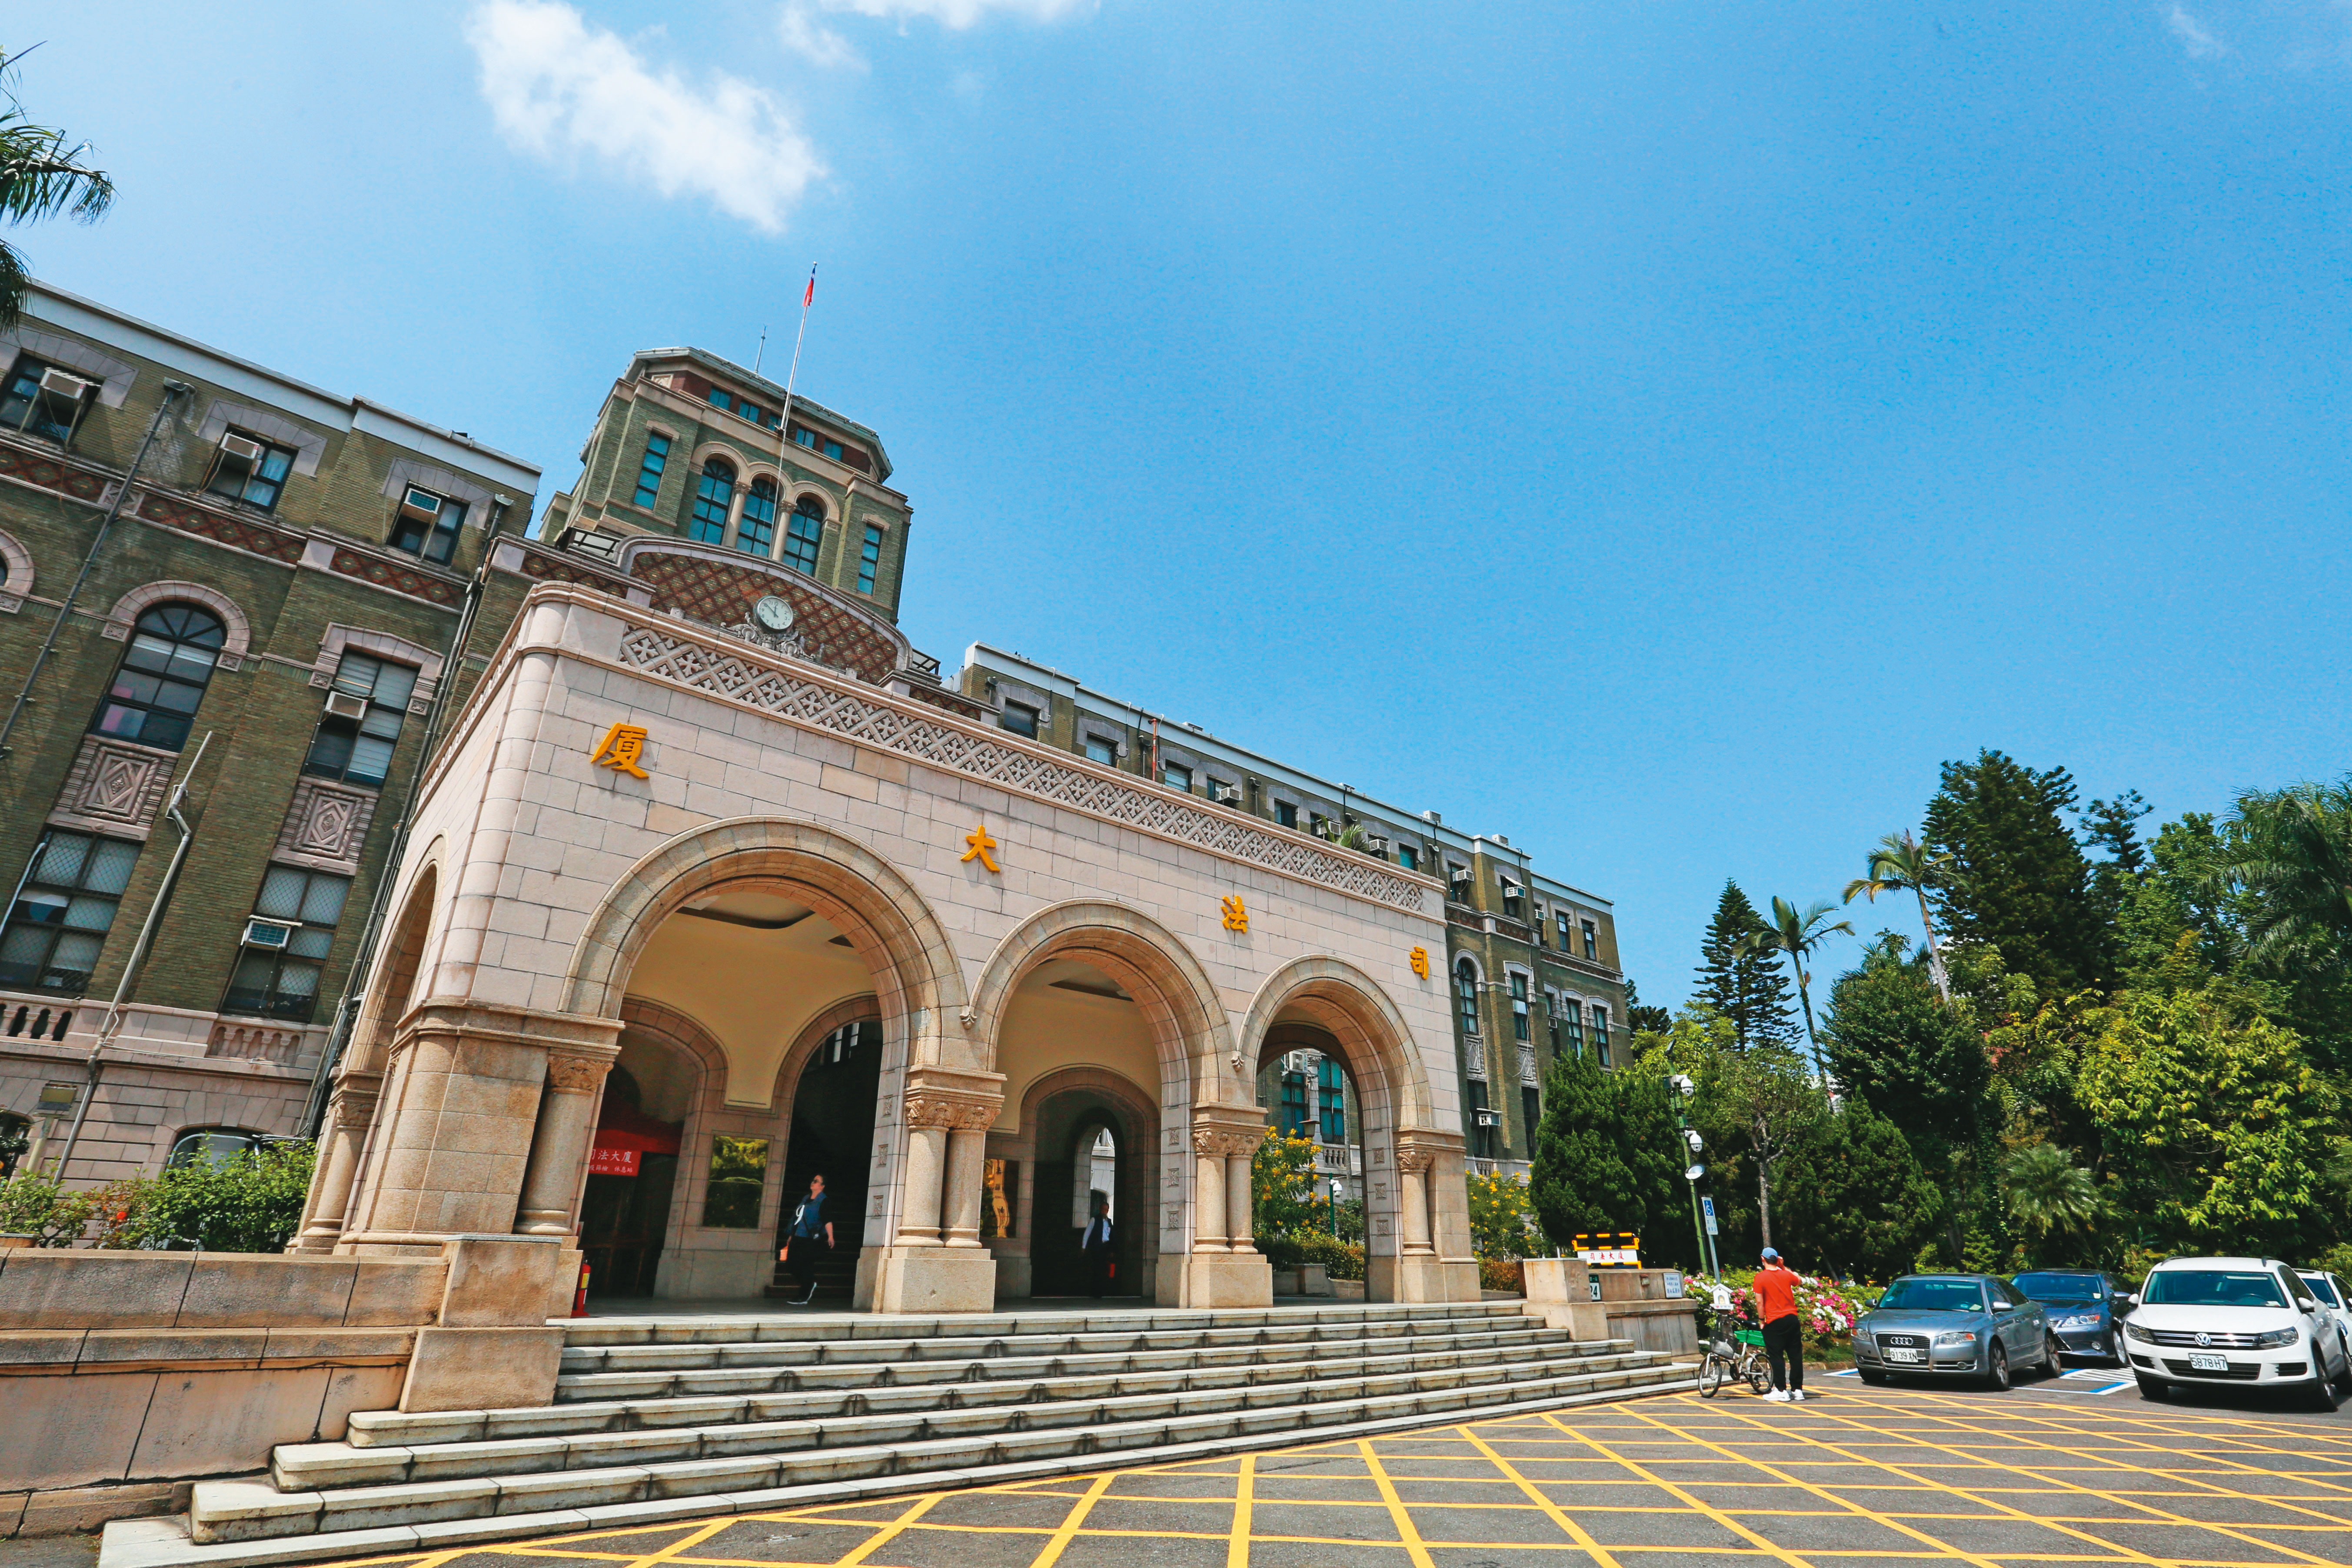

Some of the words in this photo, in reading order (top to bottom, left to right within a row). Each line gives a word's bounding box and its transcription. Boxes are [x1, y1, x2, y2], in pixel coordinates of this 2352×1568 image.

[960, 825, 1000, 873] 大
[1221, 896, 1249, 934] 法
[1410, 946, 1429, 980] 司
